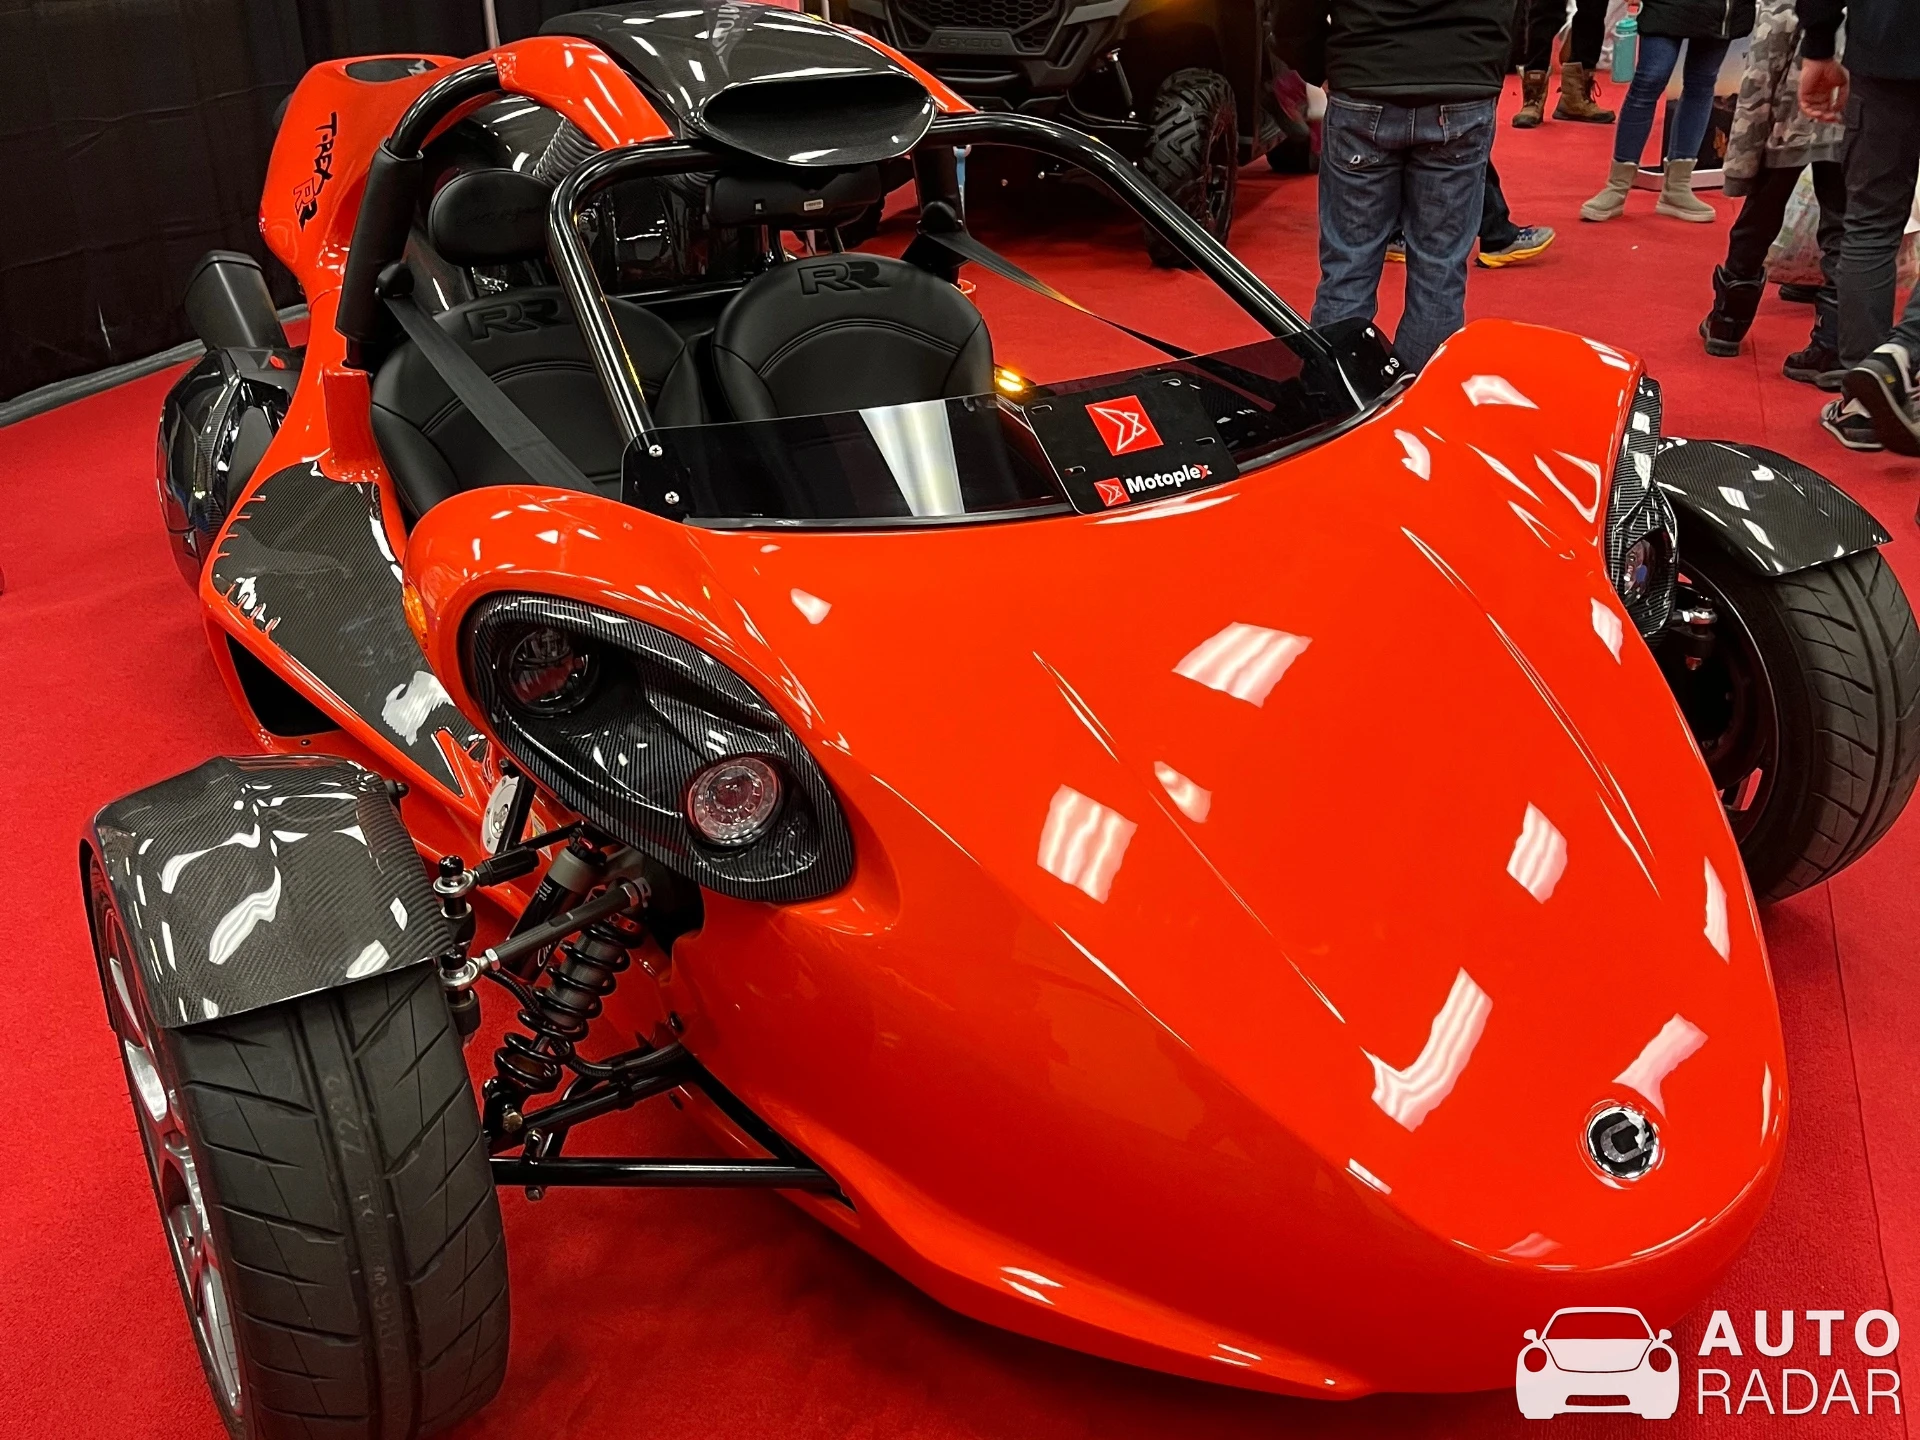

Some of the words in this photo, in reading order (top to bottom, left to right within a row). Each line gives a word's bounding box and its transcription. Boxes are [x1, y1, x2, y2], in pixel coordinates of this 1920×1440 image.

[313, 111, 338, 197] T-REX
[797, 261, 892, 295] RR
[463, 298, 573, 341] RR
[1125, 463, 1213, 494] Motoplex
